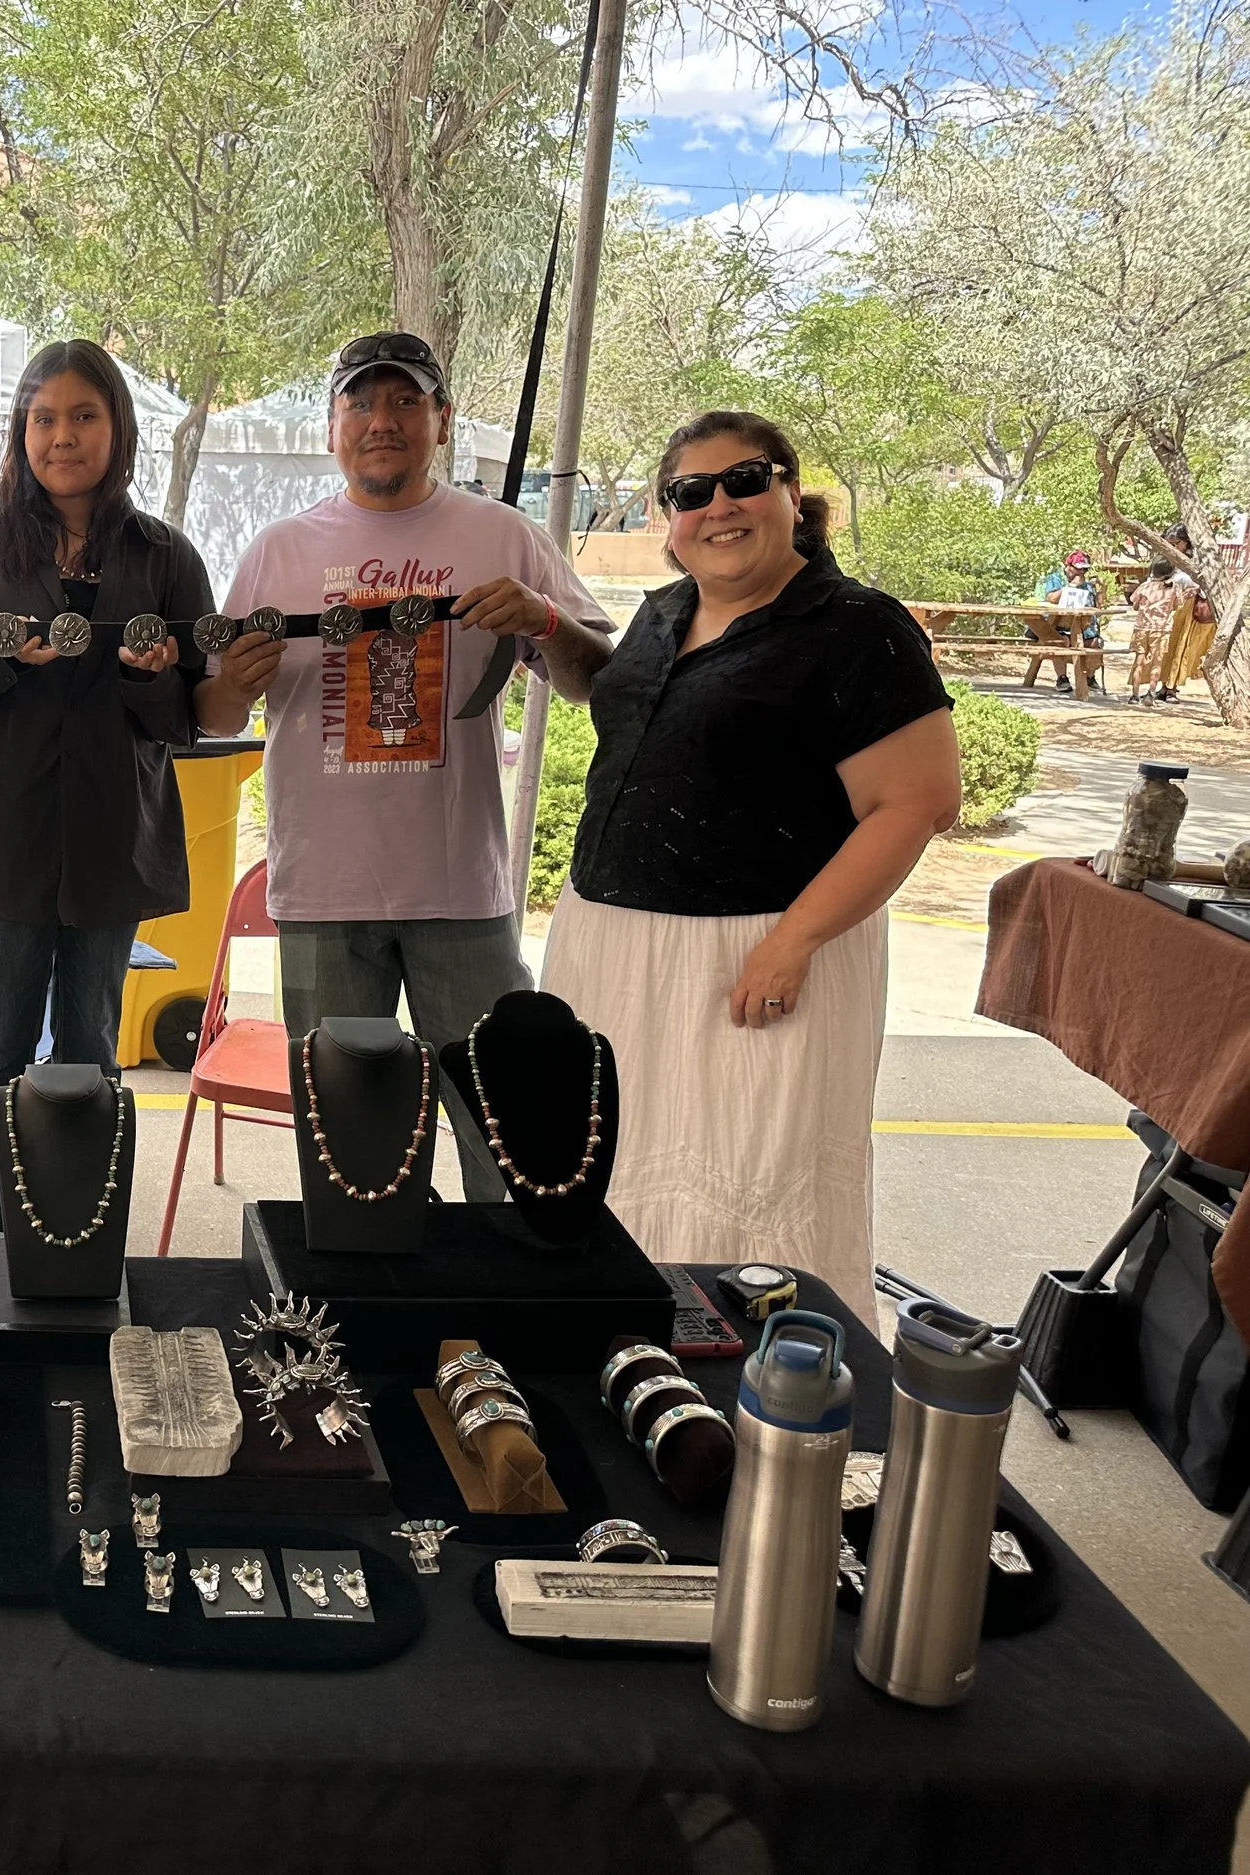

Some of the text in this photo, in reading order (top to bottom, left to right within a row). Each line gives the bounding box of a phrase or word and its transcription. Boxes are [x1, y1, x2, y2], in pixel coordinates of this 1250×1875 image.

[323, 566, 355, 581] 101ST
[358, 559, 453, 590] Gallup
[323, 581, 354, 592] ANNUAL
[348, 585, 445, 603] INTER-TRIBAL INDIAN
[322, 591, 347, 742] CMONIAL
[323, 764, 340, 774] 2023
[347, 761, 429, 774] ASSOCIATION
[767, 1698, 814, 1710] contigo
